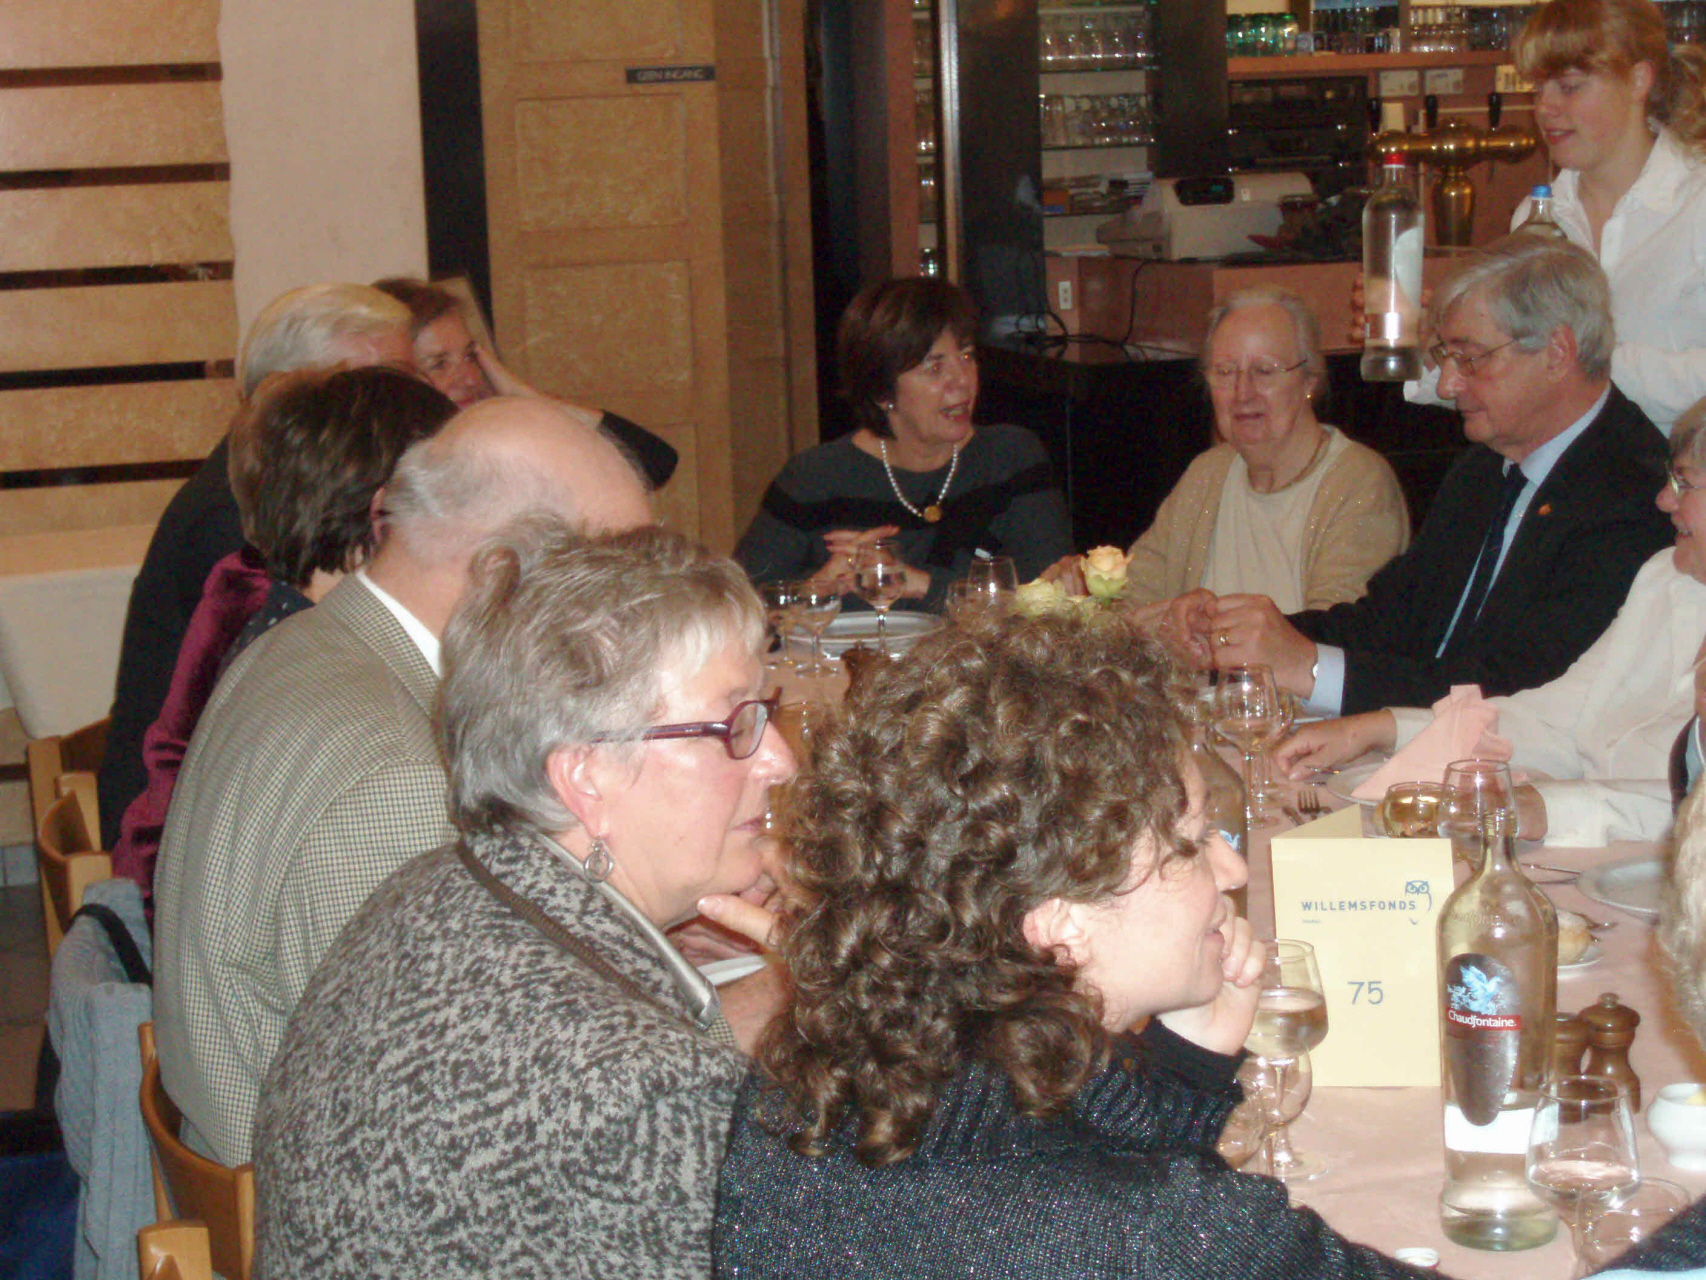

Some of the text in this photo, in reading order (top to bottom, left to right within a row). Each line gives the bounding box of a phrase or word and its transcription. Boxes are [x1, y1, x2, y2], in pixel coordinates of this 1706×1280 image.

[1301, 900, 1416, 911] WILLEMSFONDS
[1347, 980, 1384, 1005] 75
[1448, 1010, 1515, 1028] Chaudfontaine
